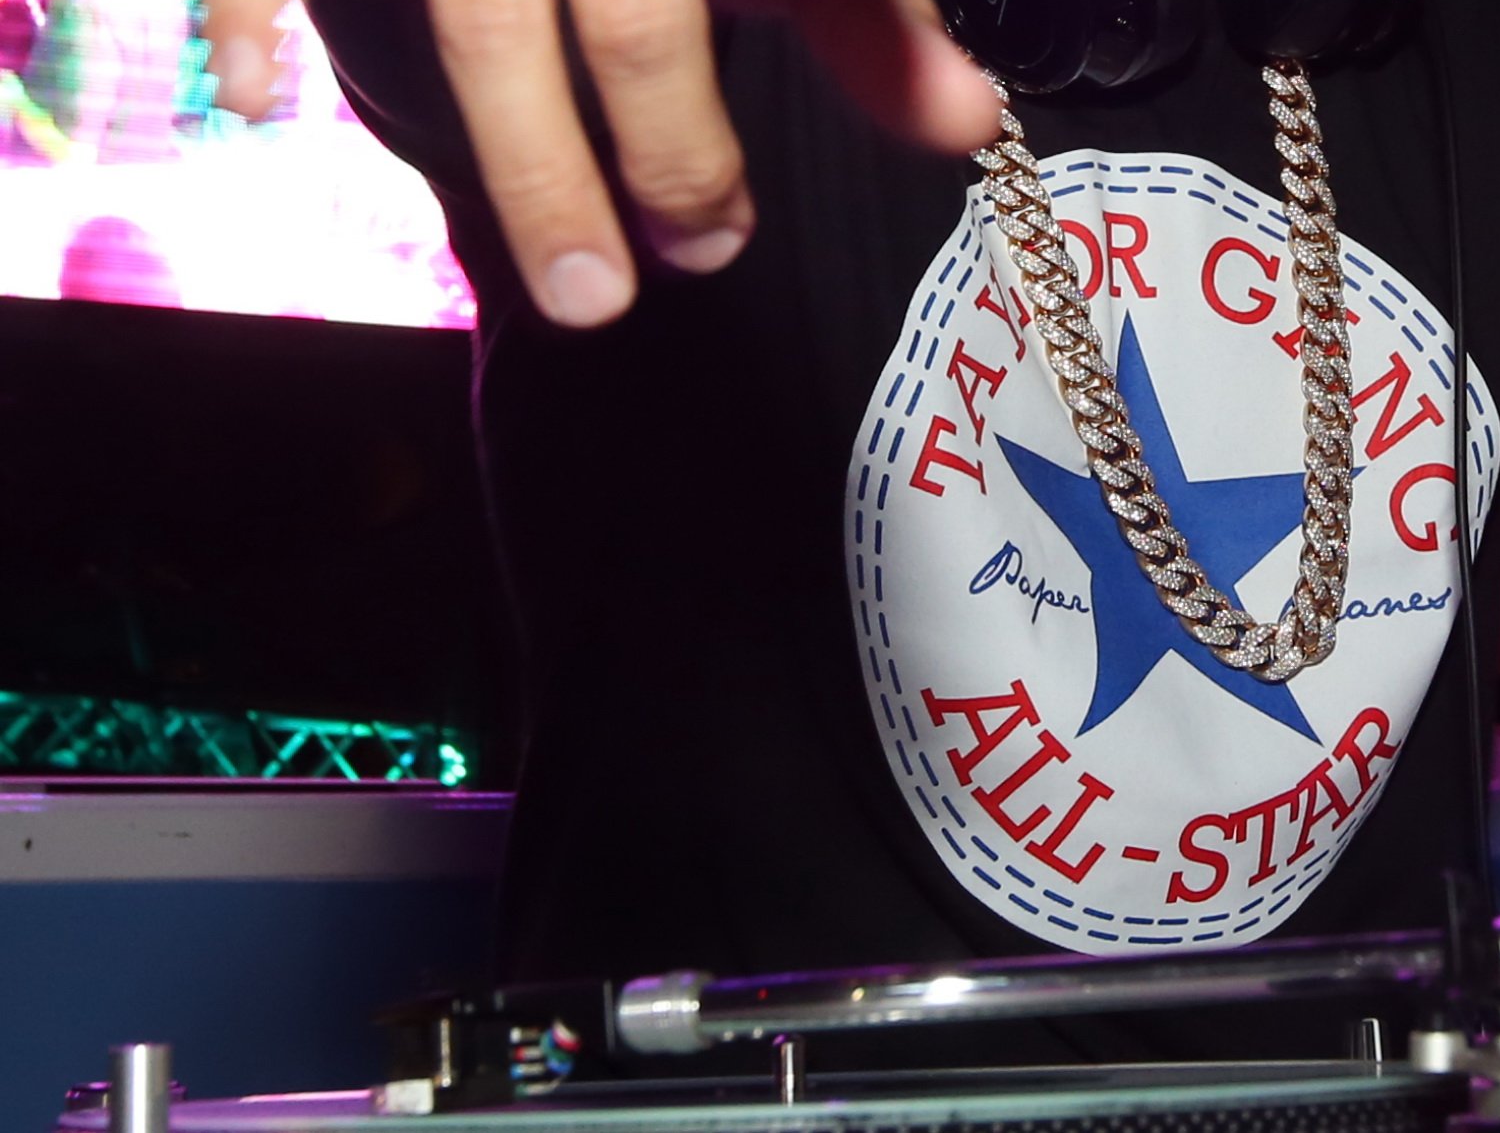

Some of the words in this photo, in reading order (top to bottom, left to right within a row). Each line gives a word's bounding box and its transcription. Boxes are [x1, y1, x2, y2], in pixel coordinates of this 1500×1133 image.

[909, 210, 1158, 497] TAYOR
[969, 539, 1090, 625] Paper
[920, 678, 1403, 905] ALL-STAR
